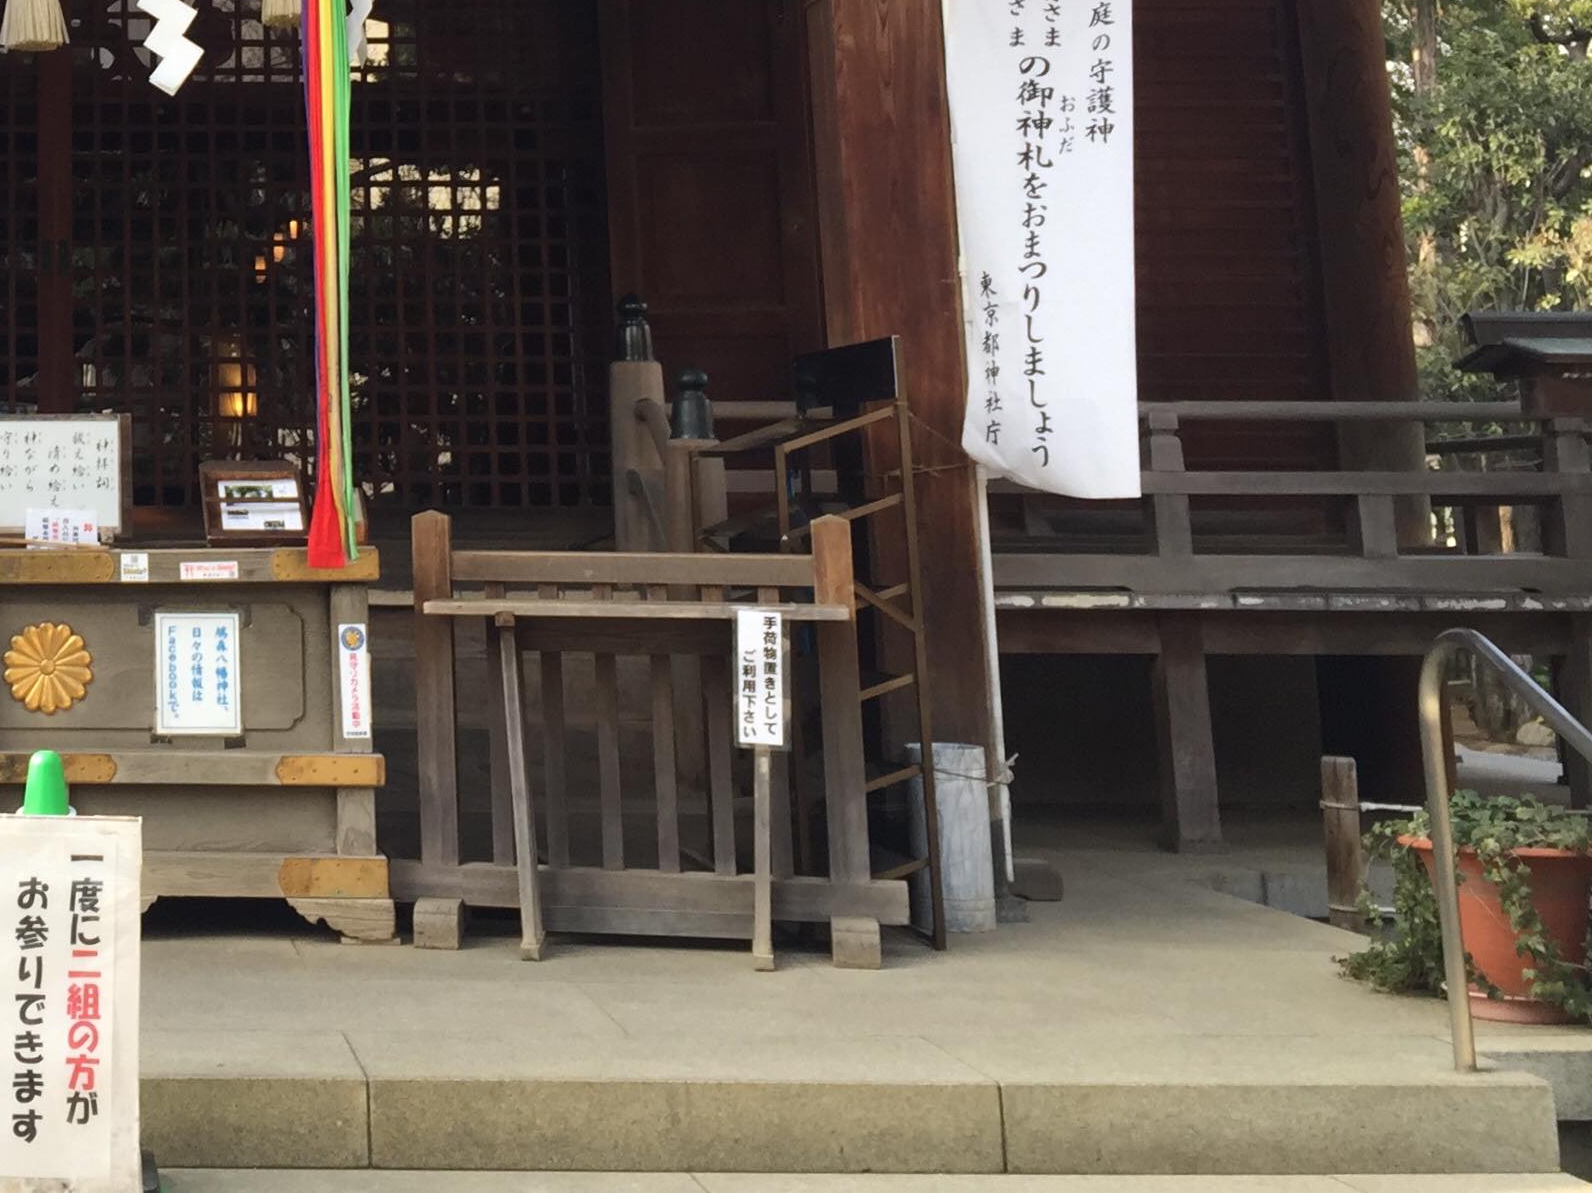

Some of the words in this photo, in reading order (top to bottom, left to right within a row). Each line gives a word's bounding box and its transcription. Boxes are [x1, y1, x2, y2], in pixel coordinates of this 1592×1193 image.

[1059, 95, 1075, 155] おふだ
[1015, 56, 1055, 467] の御神札をおまつりしましょう
[978, 271, 1003, 446] 東京都神社庁
[0, 431, 14, 490] 守り給い
[24, 431, 37, 492] 神ながら
[48, 445, 62, 507] 清め給え
[72, 431, 85, 490] 祓え給い
[96, 438, 110, 490] 神拝詞
[191, 626, 204, 702] 日々の情報は
[742, 649, 757, 738] ご利用下さい
[763, 616, 777, 735] 手荷物置きとして
[12, 876, 49, 1142] お参りできます
[65, 854, 105, 1125] 一度に二組の方が
